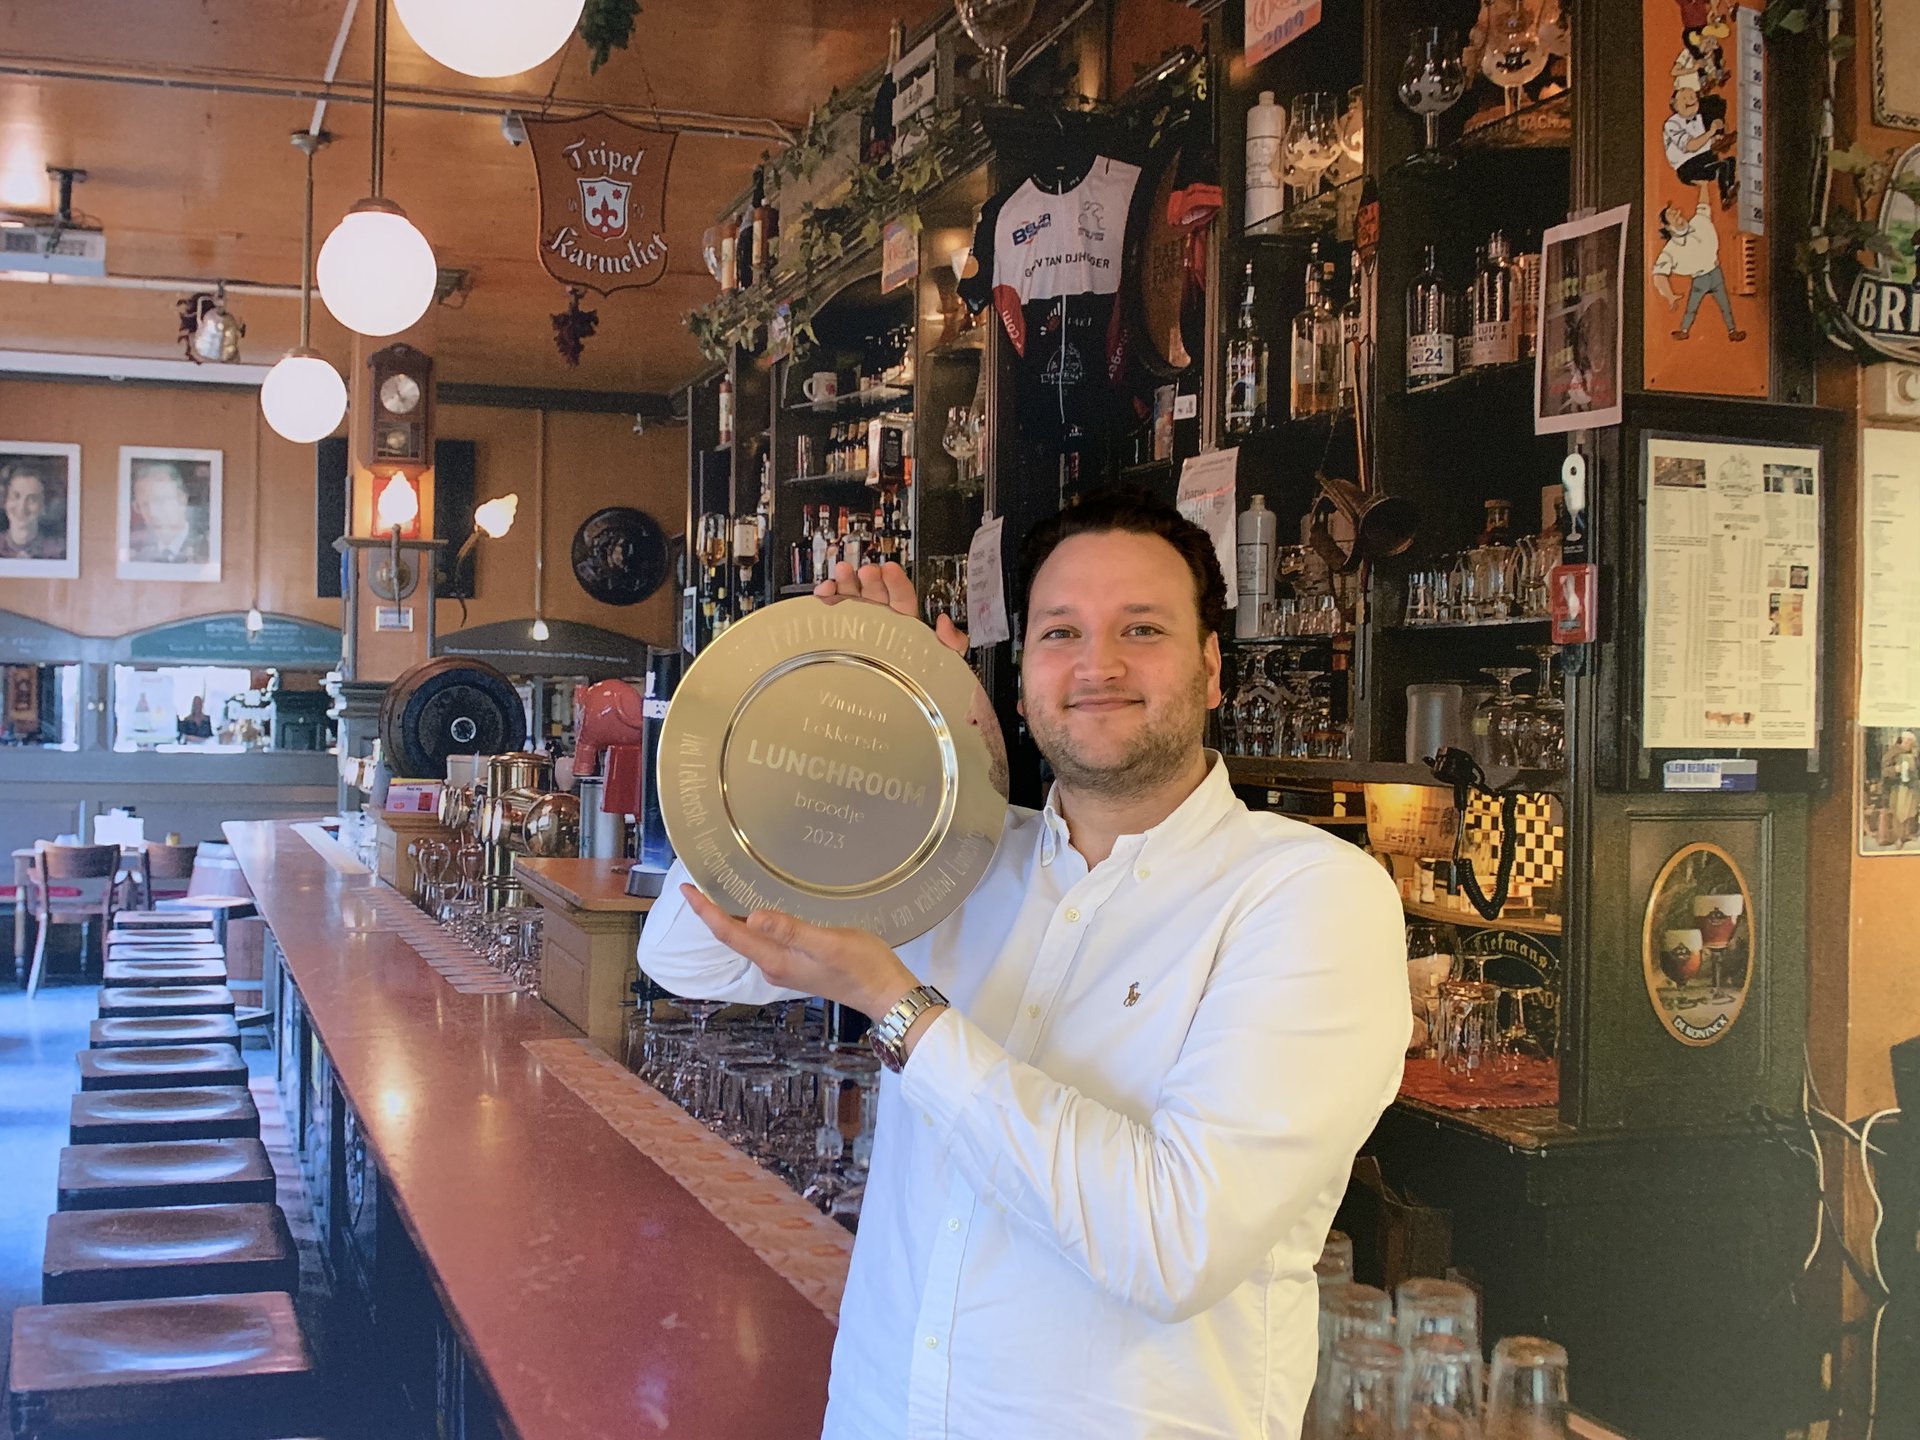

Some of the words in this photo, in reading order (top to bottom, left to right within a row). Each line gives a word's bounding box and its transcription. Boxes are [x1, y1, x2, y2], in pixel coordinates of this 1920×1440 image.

[562, 138, 645, 176] Tripel
[551, 226, 669, 274] Karmeliet
[1425, 347, 1443, 362] 24
[747, 739, 927, 808] LUNCHROOM
[795, 791, 865, 824] broodje
[802, 825, 846, 849] 2023
